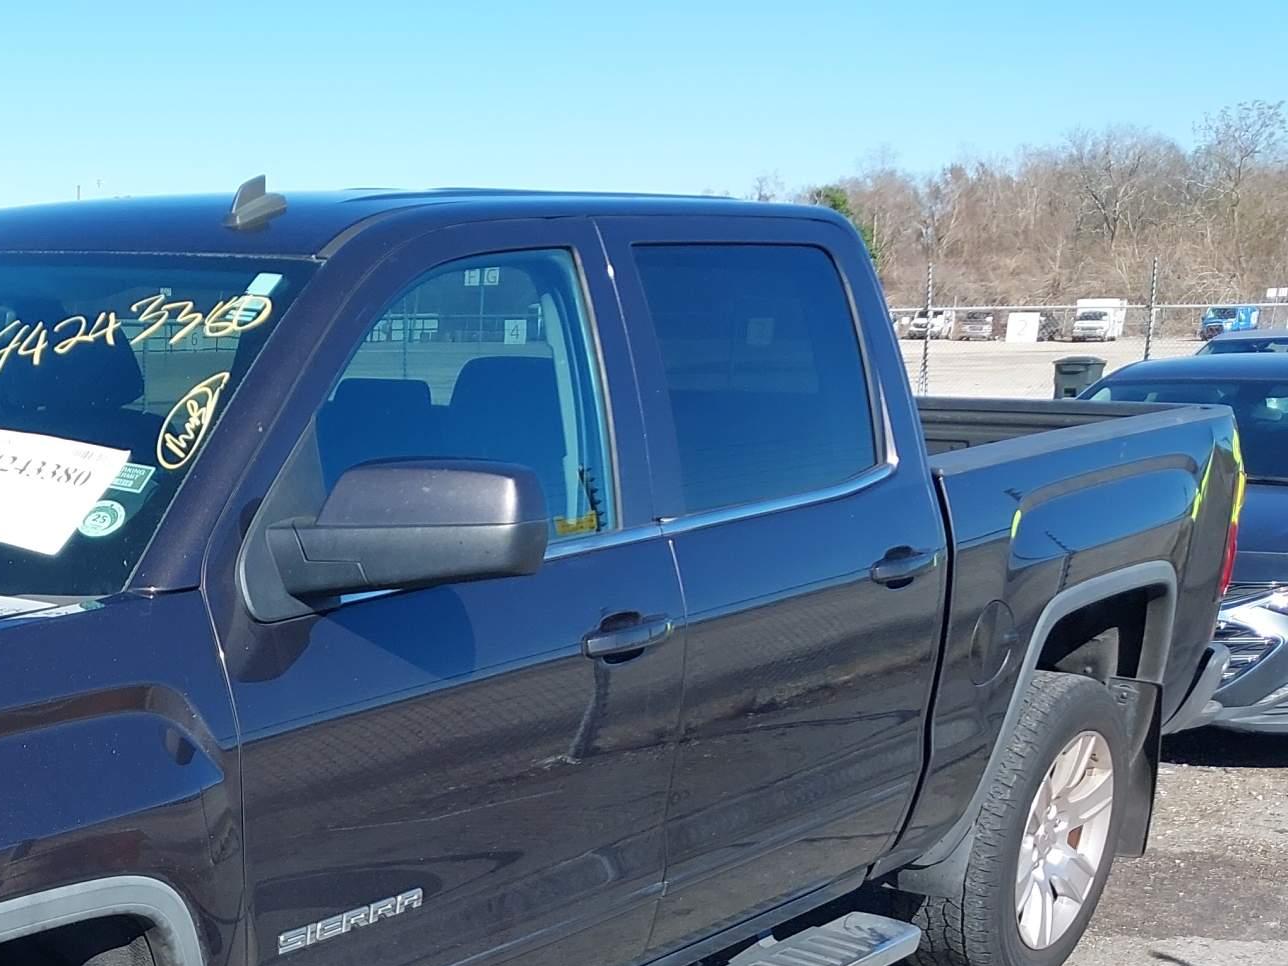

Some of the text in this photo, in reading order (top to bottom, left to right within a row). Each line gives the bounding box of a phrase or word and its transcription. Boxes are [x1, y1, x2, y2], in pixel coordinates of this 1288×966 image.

[486, 269, 497, 284] G
[510, 325, 521, 339] 4
[1016, 319, 1028, 335] 2
[91, 514, 108, 524] 25
[278, 888, 423, 955] SIERRA
